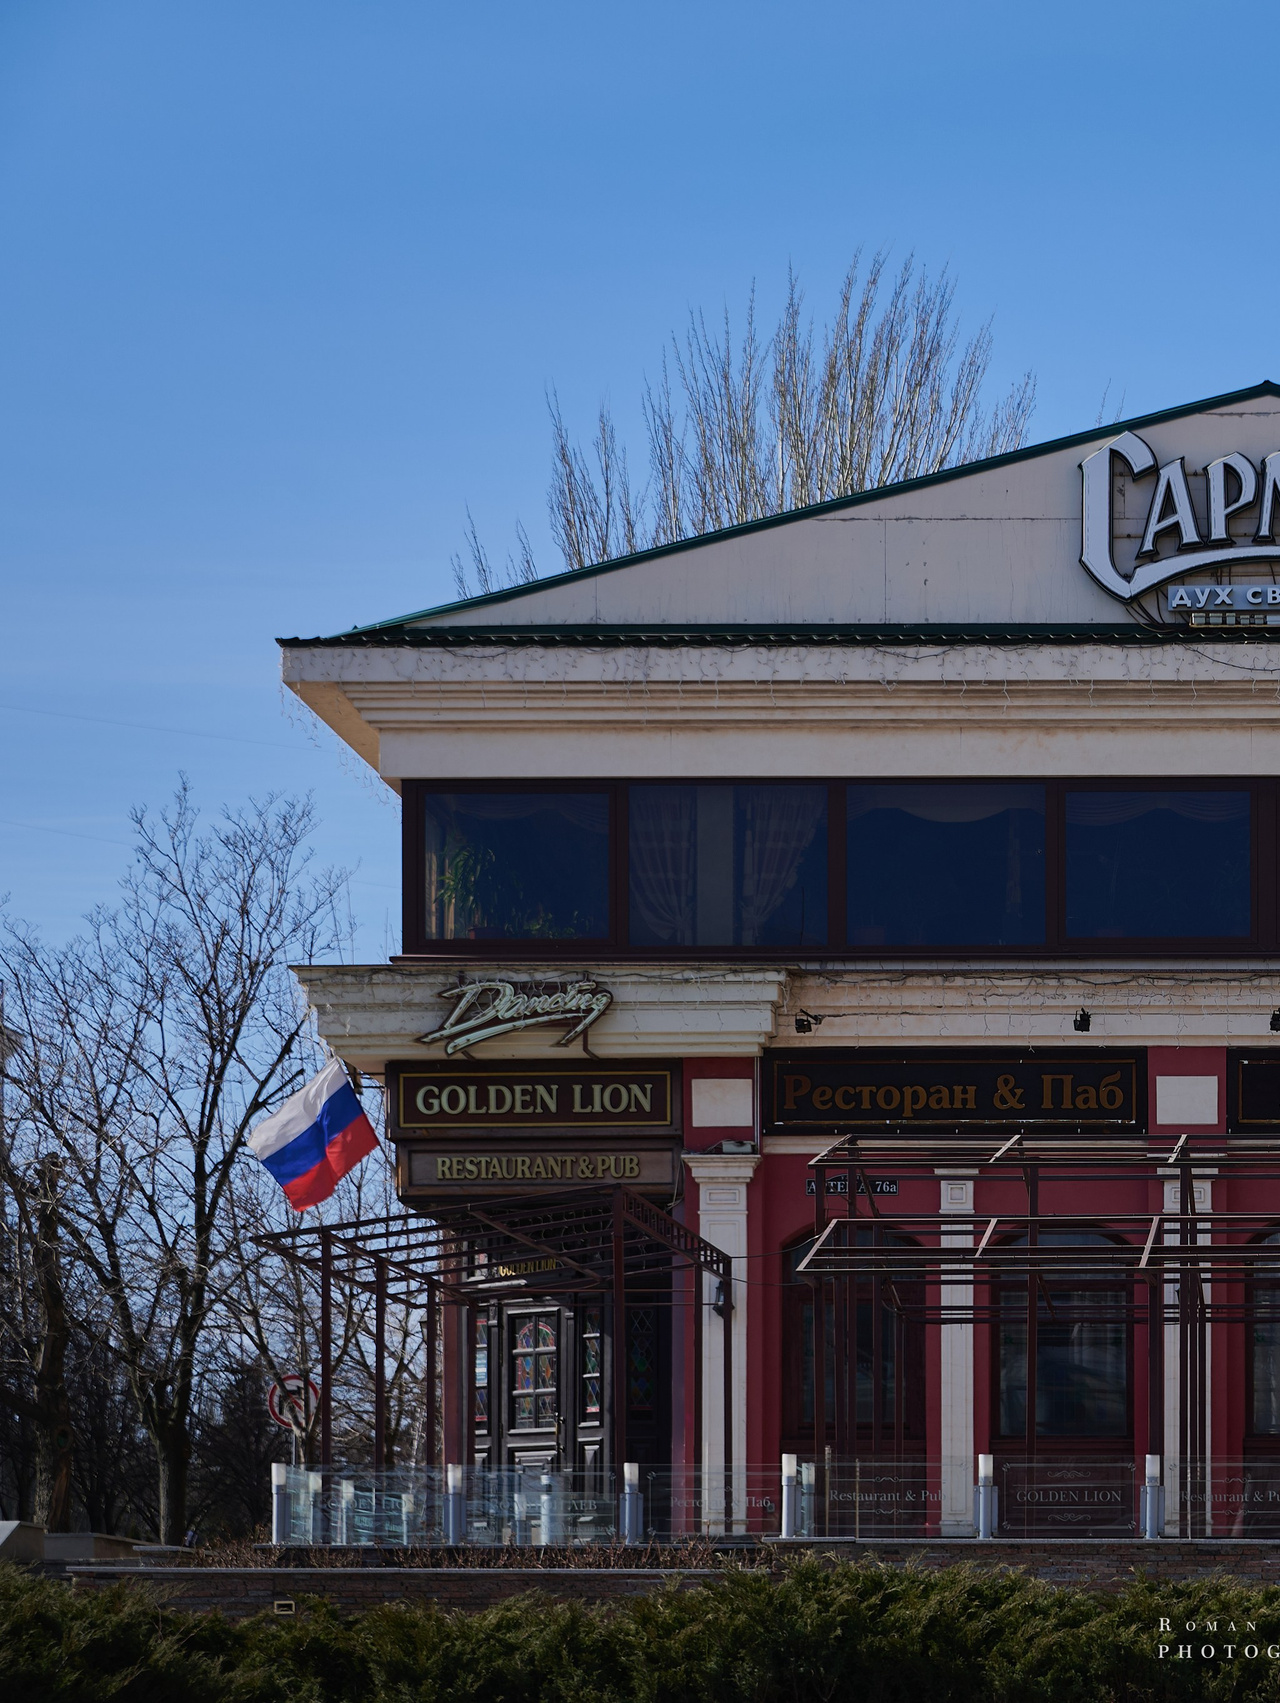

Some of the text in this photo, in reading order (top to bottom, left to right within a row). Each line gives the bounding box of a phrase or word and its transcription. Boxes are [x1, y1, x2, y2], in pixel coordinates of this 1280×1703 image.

[1171, 587, 1233, 608] ДУХ
[416, 979, 613, 1054] Dancing
[416, 1083, 654, 1115] GOLDEN LION
[783, 1071, 1124, 1117] Ресторан & Паб
[808, 1181, 898, 1193] АТЕА 76а
[829, 1489, 901, 1501] Restaurant
[905, 1489, 917, 1502] &
[1016, 1490, 1122, 1502] GOLDEN LION
[1252, 1490, 1264, 1502] &
